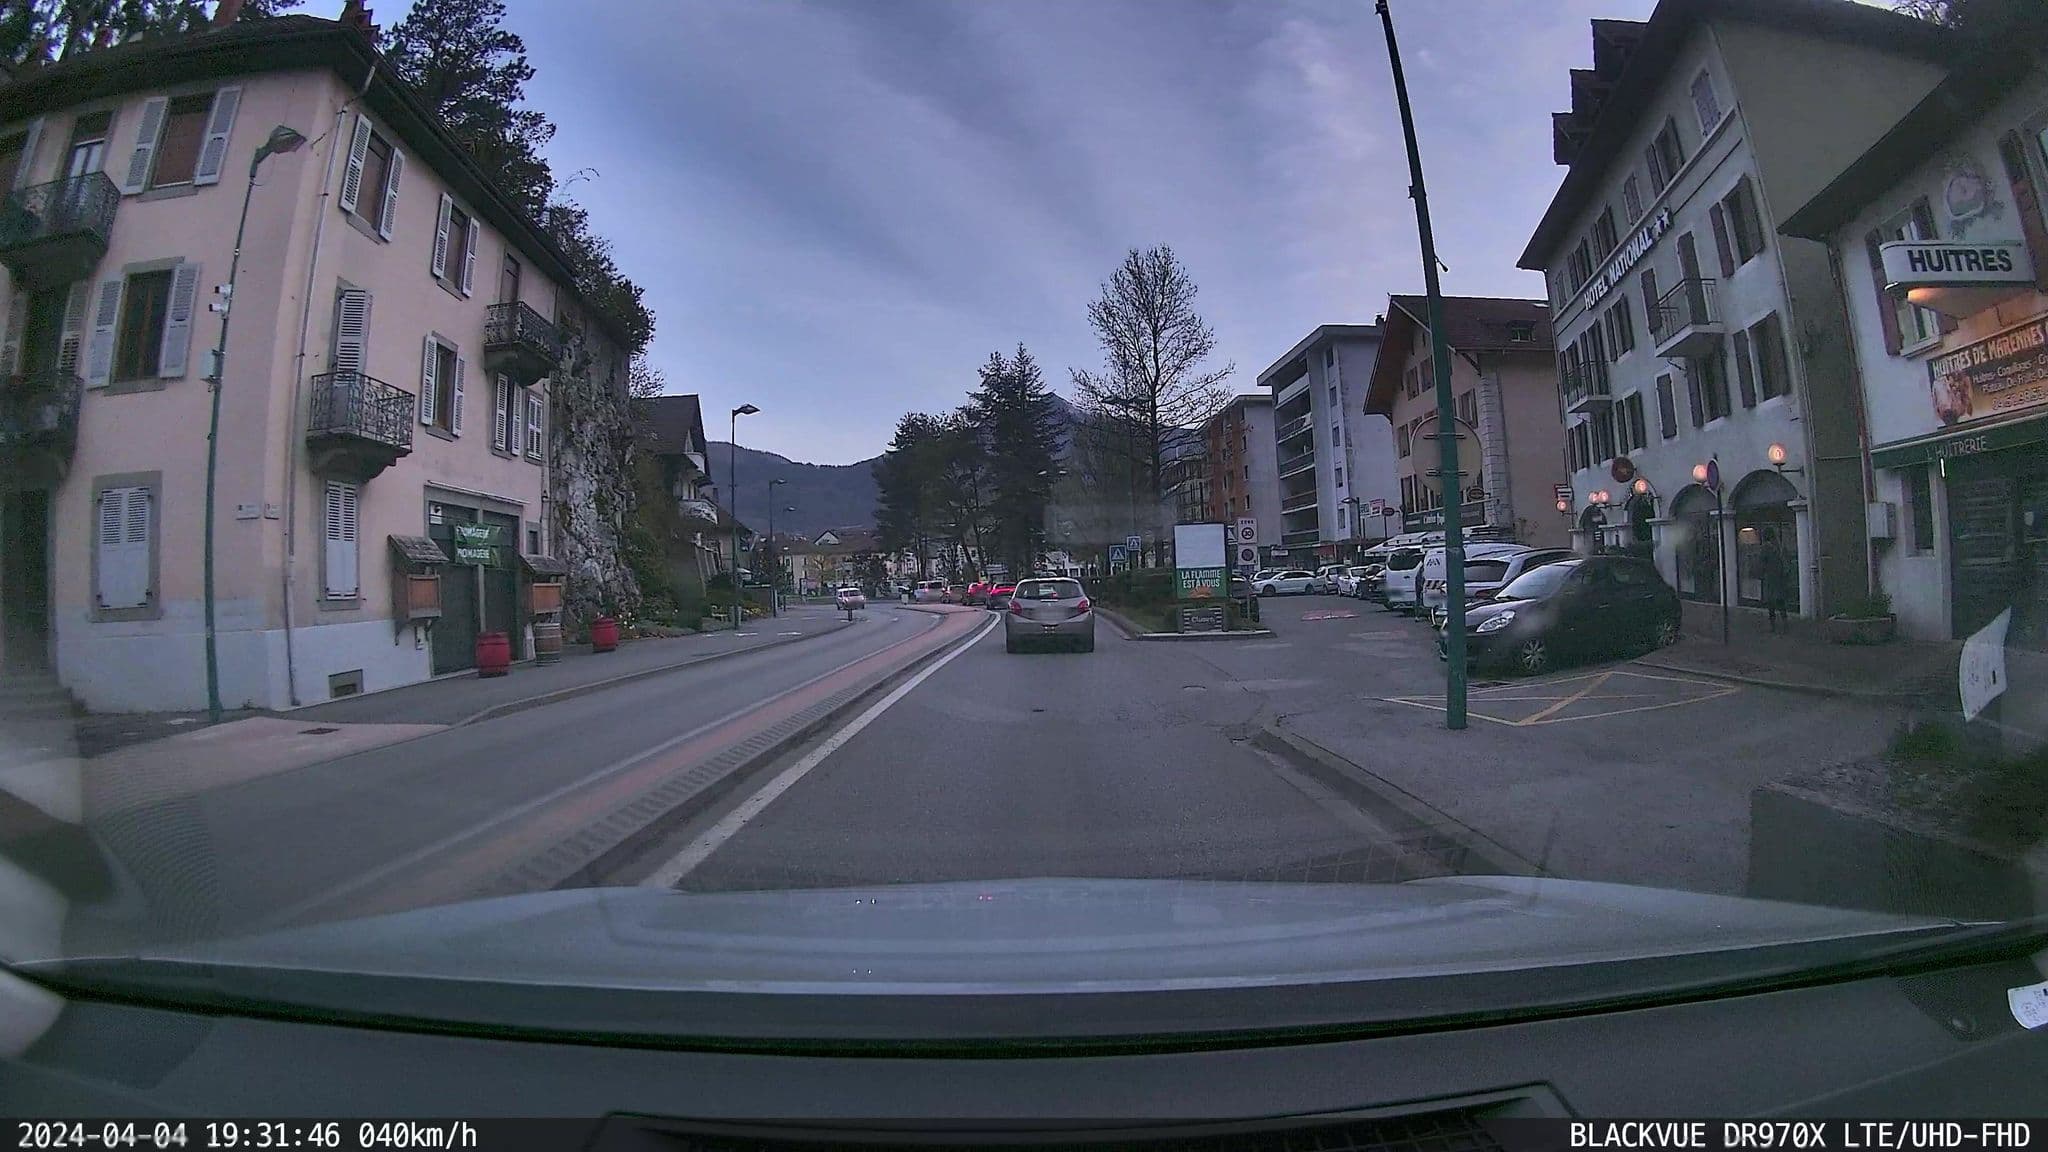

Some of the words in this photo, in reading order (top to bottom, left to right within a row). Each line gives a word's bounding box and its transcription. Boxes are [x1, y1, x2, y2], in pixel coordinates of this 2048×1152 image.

[1584, 275, 1608, 310] HOTEL
[1609, 227, 1653, 286] NATIONAL
[1973, 346, 1986, 365] DE
[1182, 571, 1190, 579] LA
[1183, 579, 1194, 588] EST
[1202, 578, 1220, 587] VOUS
